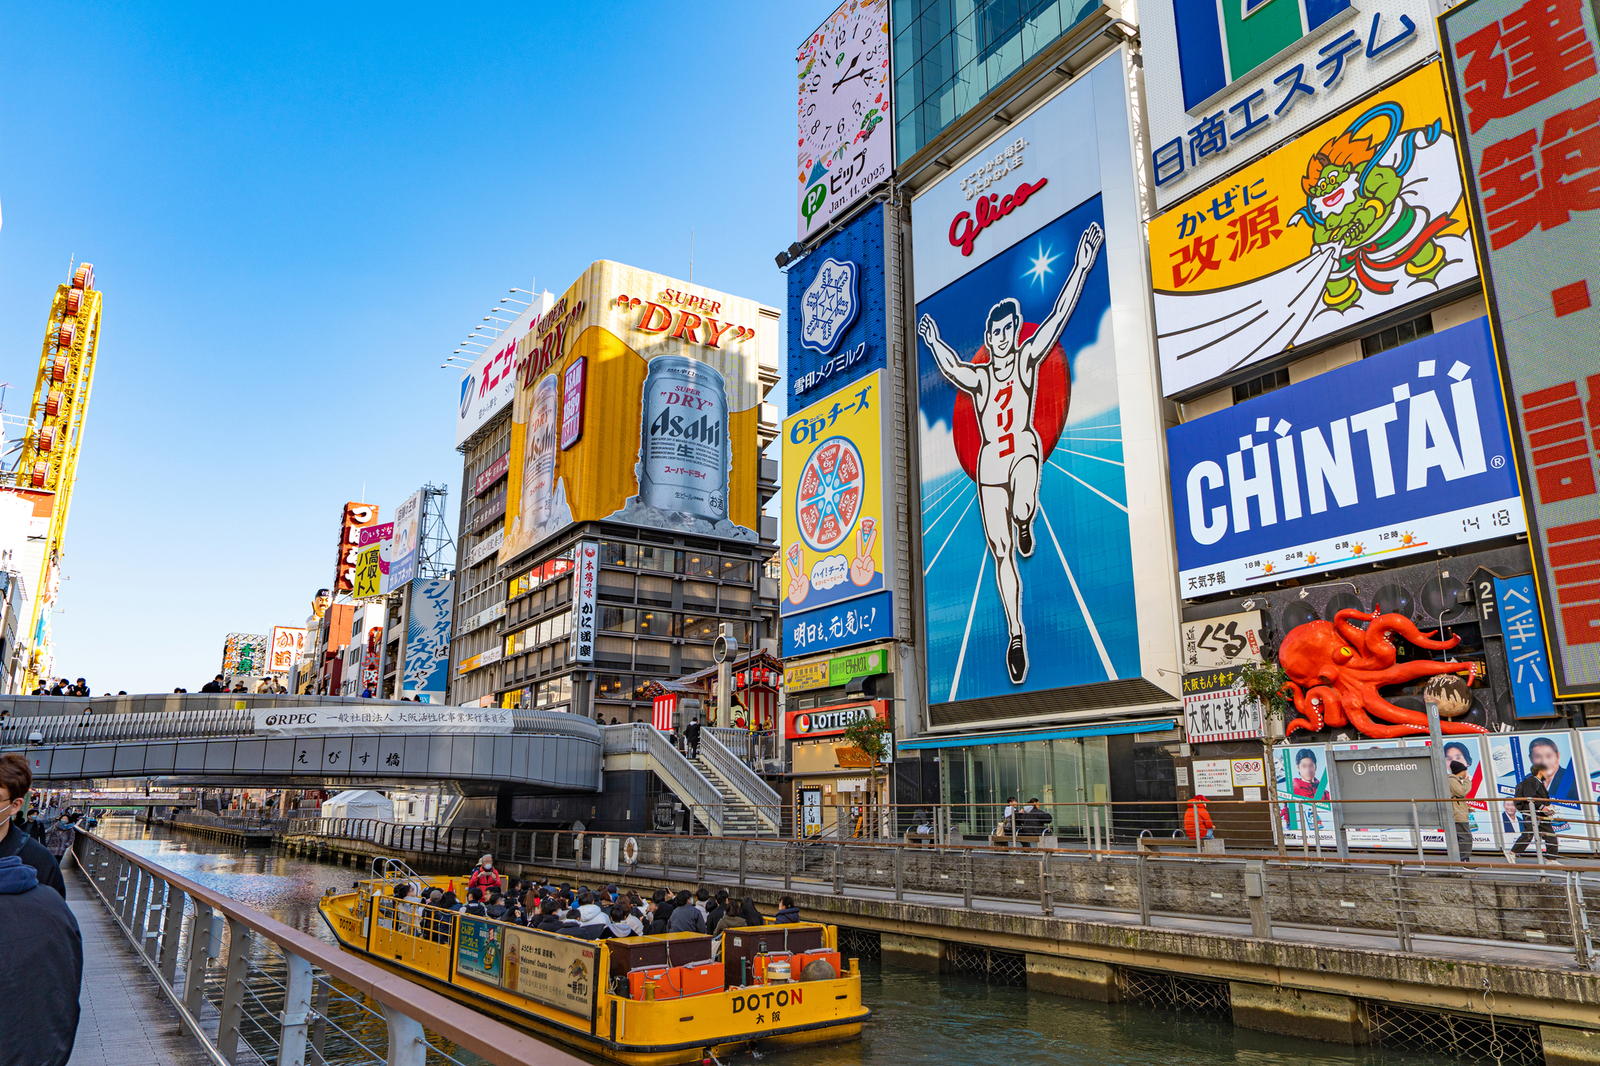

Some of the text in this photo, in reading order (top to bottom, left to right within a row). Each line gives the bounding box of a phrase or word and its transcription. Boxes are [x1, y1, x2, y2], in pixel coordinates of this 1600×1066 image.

[1152, 12, 1416, 188] 日商エステム
[828, 196, 848, 214] Jan.
[861, 163, 885, 189] 2025
[830, 148, 868, 195] ピップ
[949, 177, 1048, 257] Glico
[1176, 177, 1268, 240] かぜに
[1169, 195, 1284, 289] 改源
[536, 297, 567, 340] SUPER
[663, 288, 722, 315] SUPER
[794, 342, 866, 396] 雪印メグミルク
[563, 393, 580, 422] 1889
[675, 385, 701, 396] SUPER
[651, 406, 720, 448] Asahi
[994, 380, 1015, 458] グリコ
[527, 423, 554, 469] Asahi
[677, 444, 694, 459] 生
[1186, 359, 1488, 546] CHINTAI
[664, 466, 706, 480] スーパードライ
[1378, 530, 1399, 541] 12時
[357, 550, 370, 596] バイト
[365, 549, 380, 595] 高収入
[583, 560, 595, 599] 本場の味
[1188, 570, 1226, 591] 天気予報
[1479, 581, 1494, 621] 2F
[580, 602, 593, 657] かに道楽
[1197, 621, 1248, 660] くくる
[326, 713, 394, 723] 一般社団法人
[812, 709, 867, 729] LOTTERIA
[297, 750, 401, 768] えびす橋
[1368, 762, 1417, 772] information
[520, 956, 566, 973] Welcome! Osaka Dotonbori
[534, 947, 541, 956] 大阪
[582, 949, 594, 959] KIRIN
[732, 988, 803, 1014] DOTON
[756, 1010, 781, 1025] 大阪
